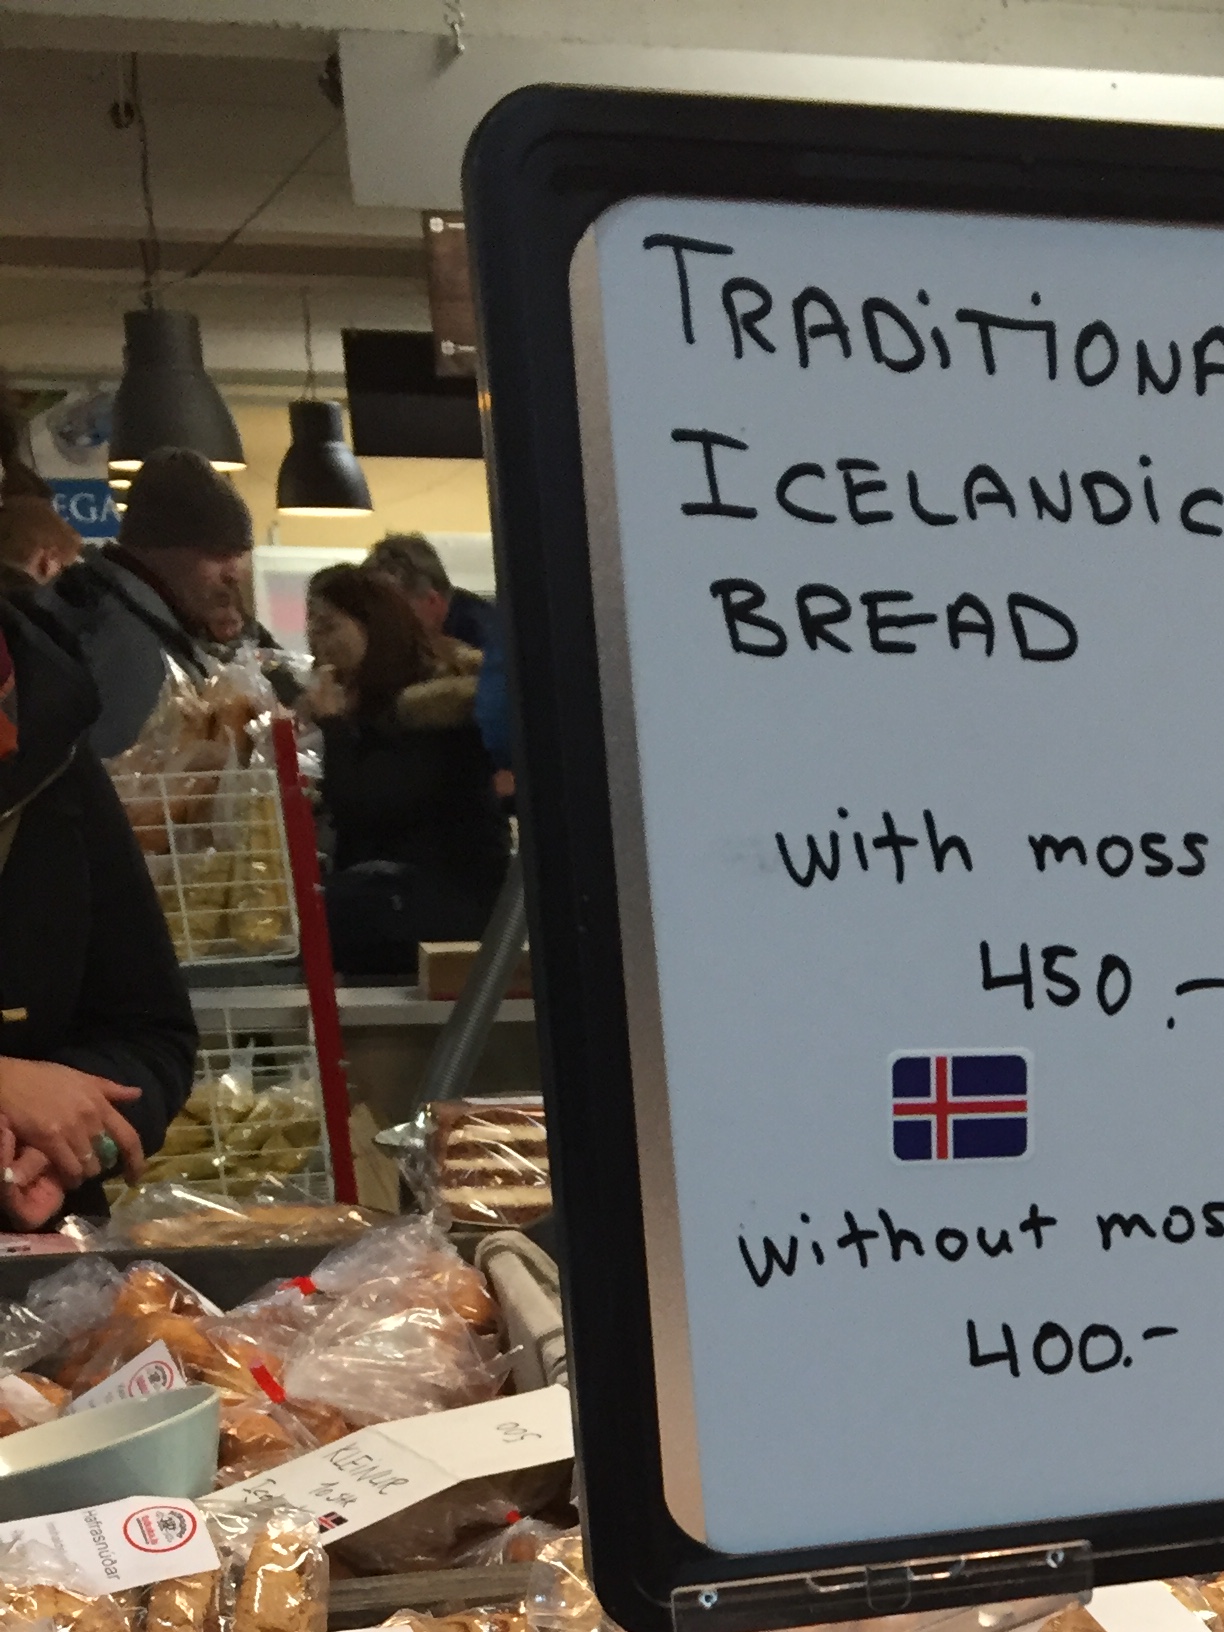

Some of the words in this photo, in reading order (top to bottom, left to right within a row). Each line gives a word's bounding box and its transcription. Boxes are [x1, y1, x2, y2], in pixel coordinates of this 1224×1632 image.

[710, 577, 1080, 662] BREAD
[777, 806, 973, 887] with
[1028, 829, 1209, 878] moss
[738, 1203, 1057, 1288] without
[966, 1319, 1179, 1378] 400.-
